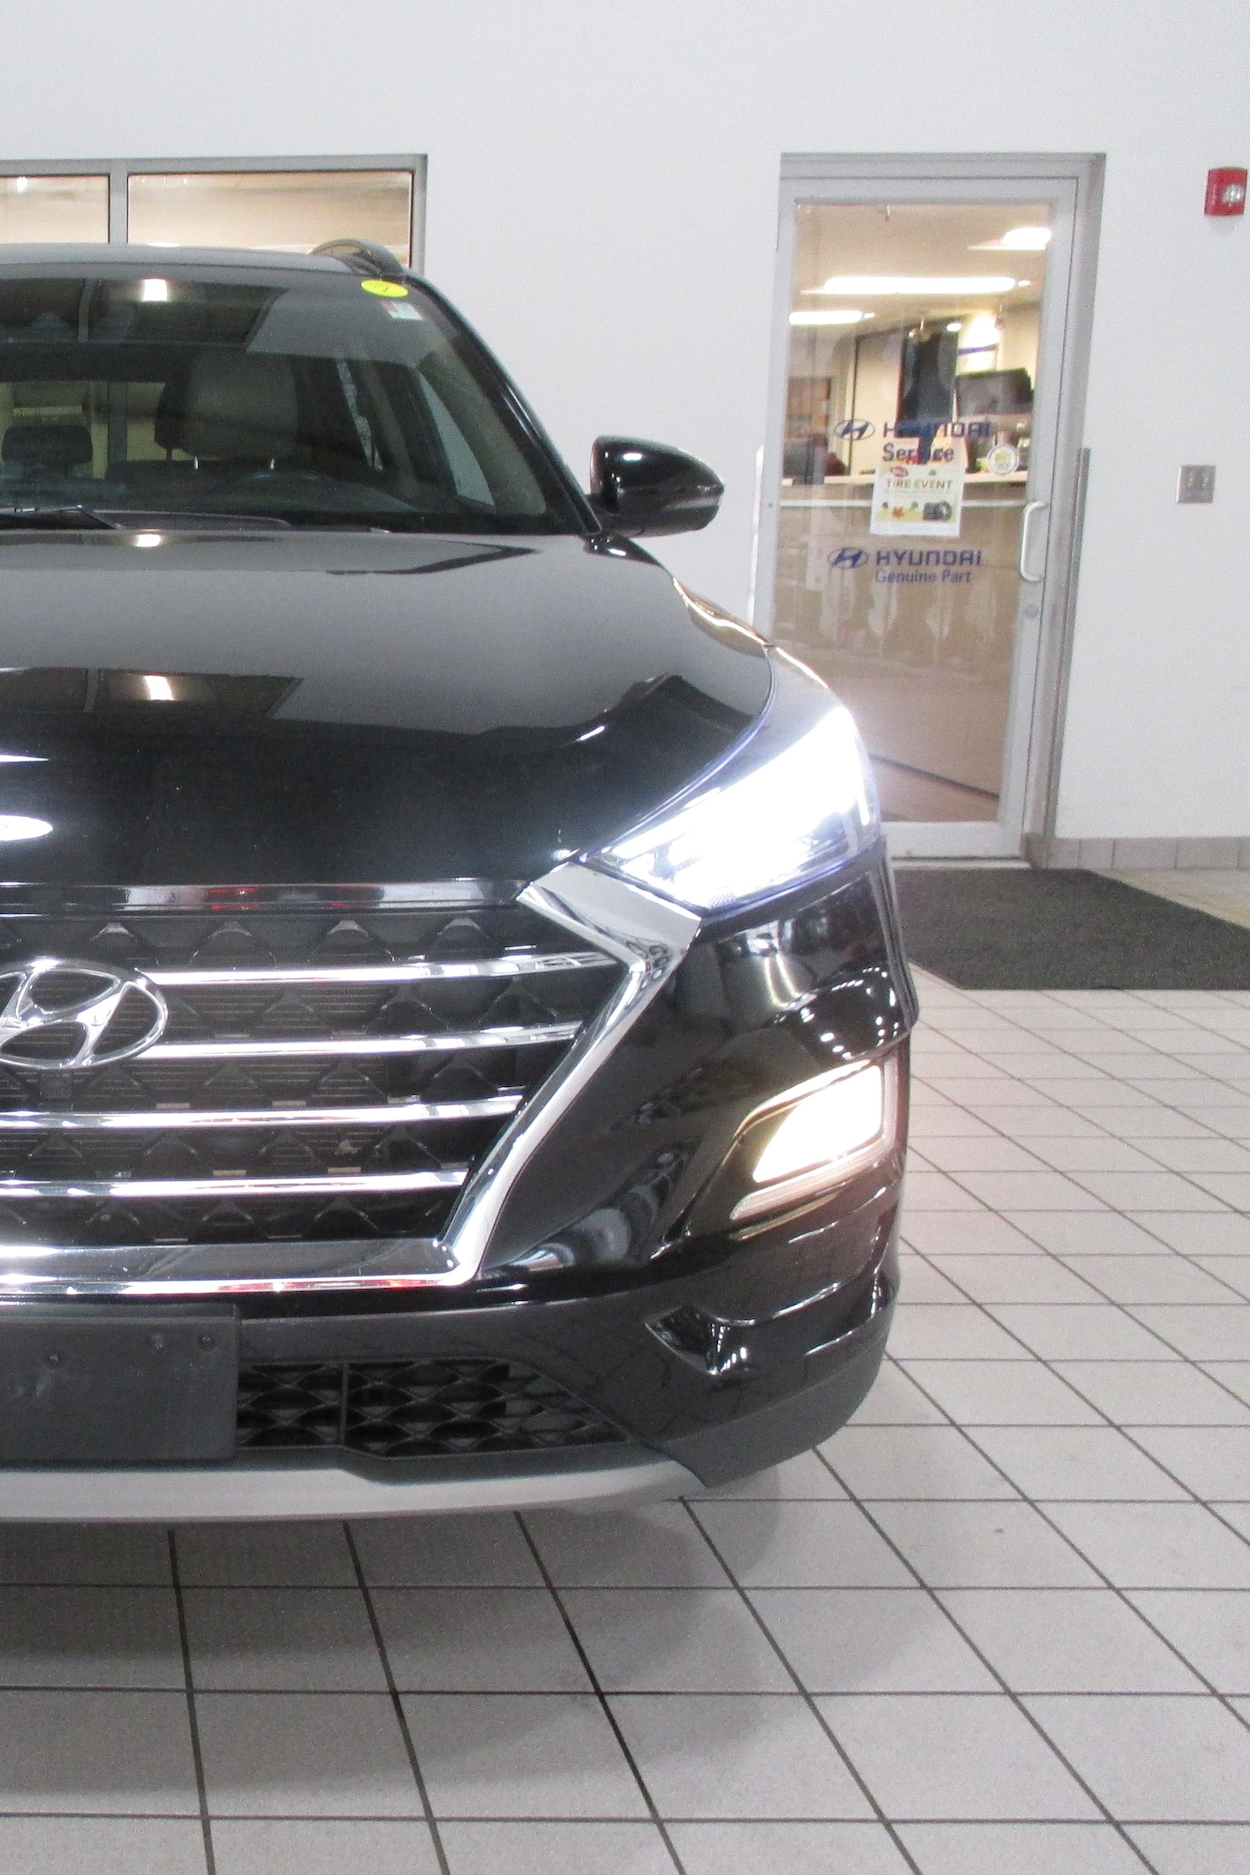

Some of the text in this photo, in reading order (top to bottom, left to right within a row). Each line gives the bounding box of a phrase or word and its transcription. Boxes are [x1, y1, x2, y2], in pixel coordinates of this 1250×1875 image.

[882, 442, 955, 463] Serce
[886, 479, 955, 490] TIRE EVENT
[876, 549, 982, 566] HYUNDAI
[875, 569, 972, 583] Genuine Part
